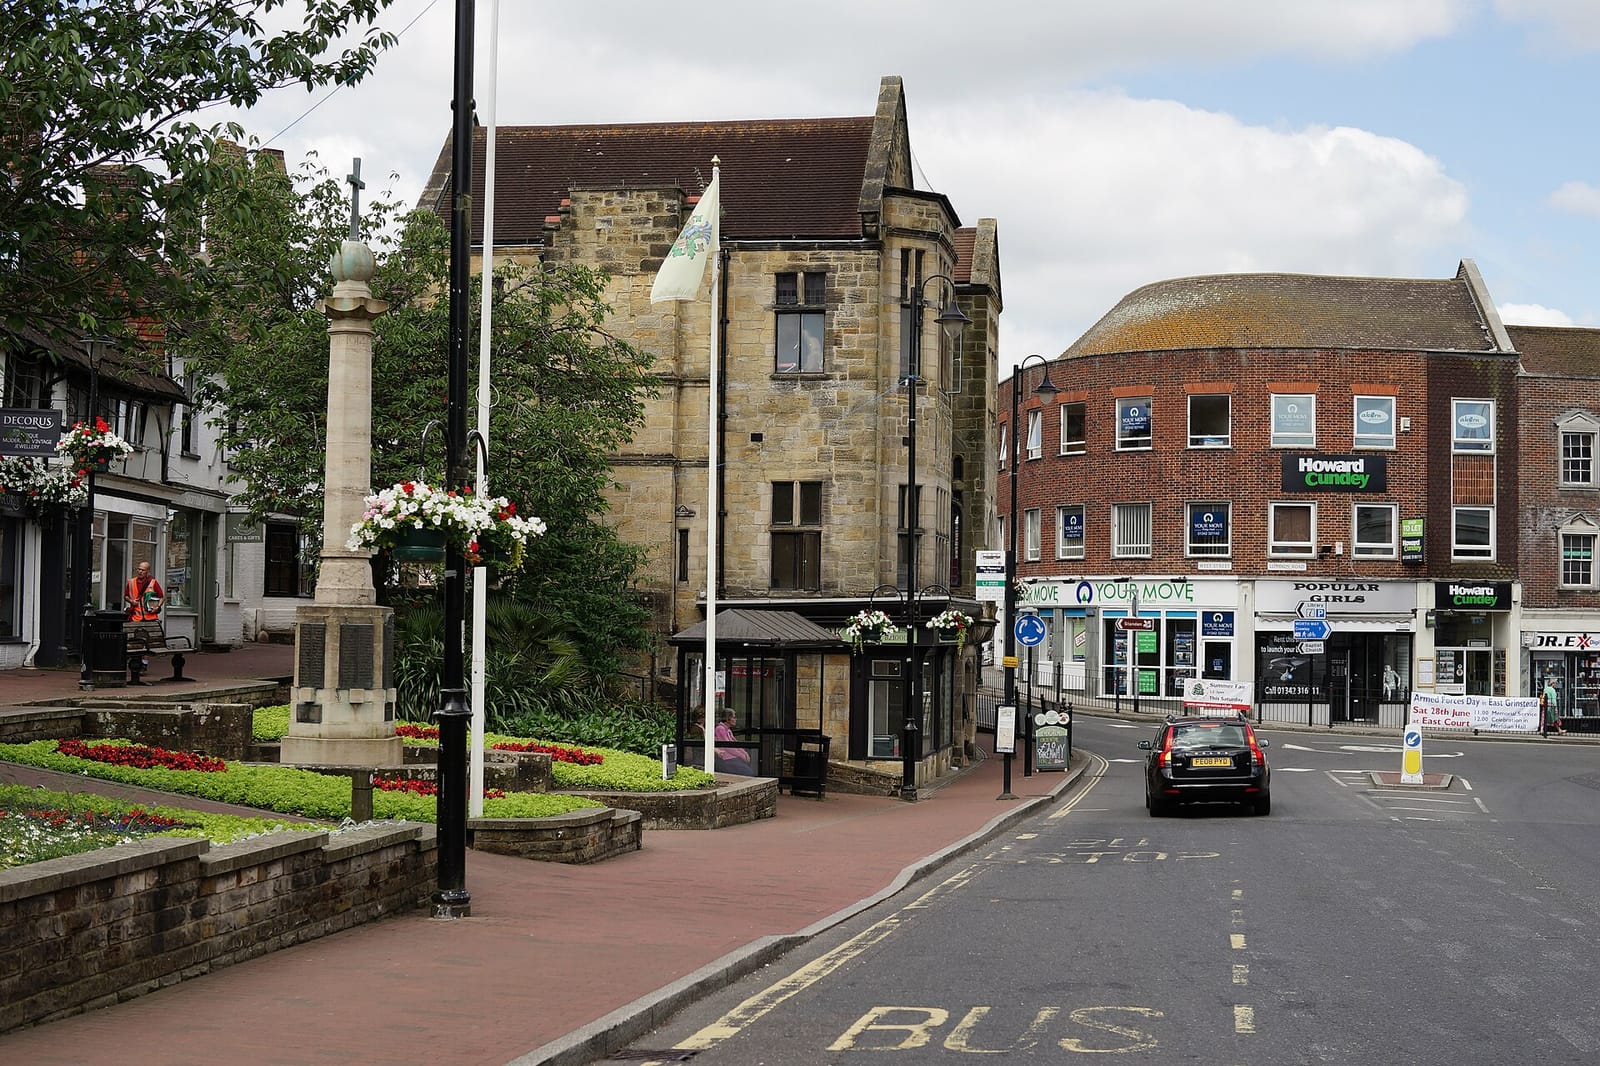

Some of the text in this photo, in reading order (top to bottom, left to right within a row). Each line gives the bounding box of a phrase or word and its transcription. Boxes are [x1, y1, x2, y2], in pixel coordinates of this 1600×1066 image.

[3, 415, 55, 429] DECORUS
[1298, 458, 1364, 472] Howard
[1305, 472, 1370, 488] Cundey
[1403, 524, 1422, 532] TO LET
[1095, 583, 1195, 602] YOUR MOVE
[1294, 583, 1379, 592] POPULAR
[1449, 584, 1494, 595] Howard
[1034, 585, 1058, 603] MOVE
[1310, 595, 1365, 603] GIRLS
[1453, 595, 1498, 606] Cundey
[1264, 686, 1276, 694] Call
[1277, 686, 1296, 694] 01342
[1413, 694, 1438, 704] Armed
[1441, 696, 1465, 705] Forces
[1466, 697, 1480, 707] Day
[1505, 699, 1538, 708] Grinstead
[1412, 706, 1471, 717] Sat 28th June
[1422, 716, 1441, 725] East
[1444, 718, 1471, 727] Court
[1036, 851, 1221, 863] STOP
[825, 1005, 1165, 1054] BUS
